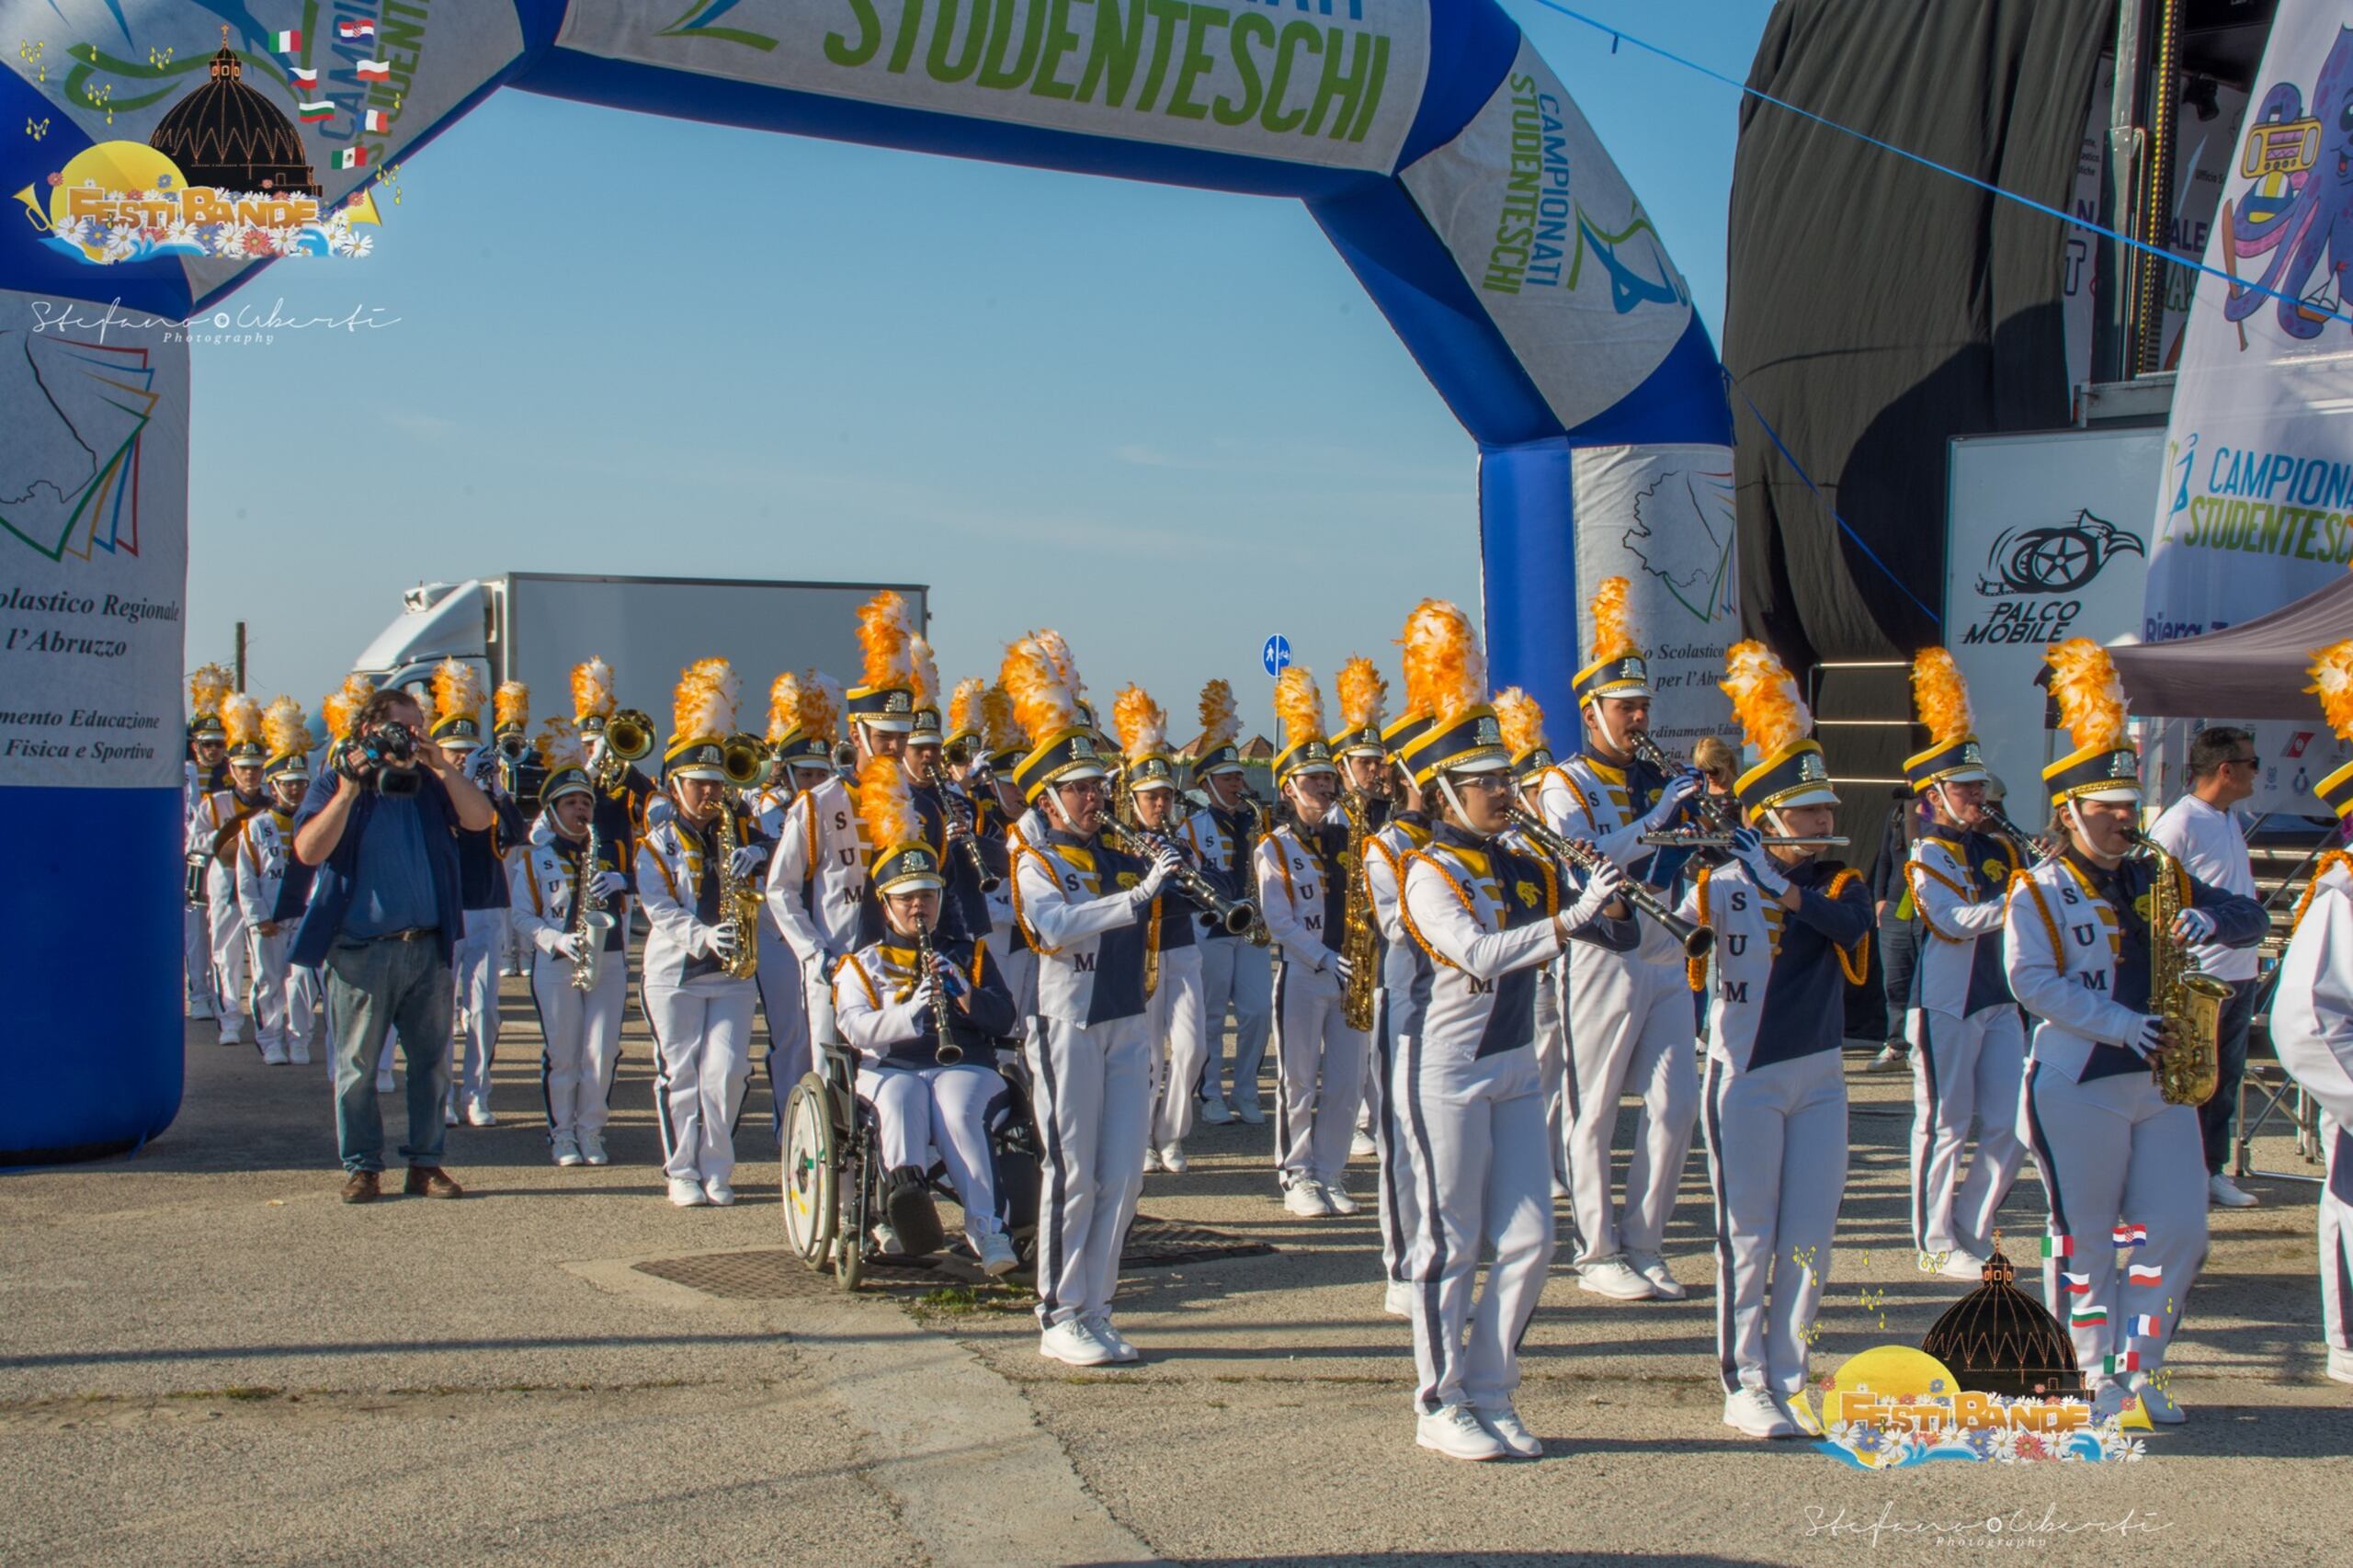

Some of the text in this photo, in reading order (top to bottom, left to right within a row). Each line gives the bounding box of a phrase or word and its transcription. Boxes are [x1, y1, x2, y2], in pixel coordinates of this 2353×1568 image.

[1482, 73, 1543, 295] STUDENTESCHI
[1525, 93, 1570, 287] CAMPIONATI
[102, 594, 180, 624] Regionale
[1988, 600, 2082, 623] PALCO
[6, 628, 127, 658] l'Abruzzo
[1961, 621, 2070, 644] MOBILE
[1657, 643, 1725, 660] Scolastico
[1655, 675, 1682, 692] per
[69, 709, 160, 731] Educazione
[5, 738, 154, 764] Fisica e Sportiva
